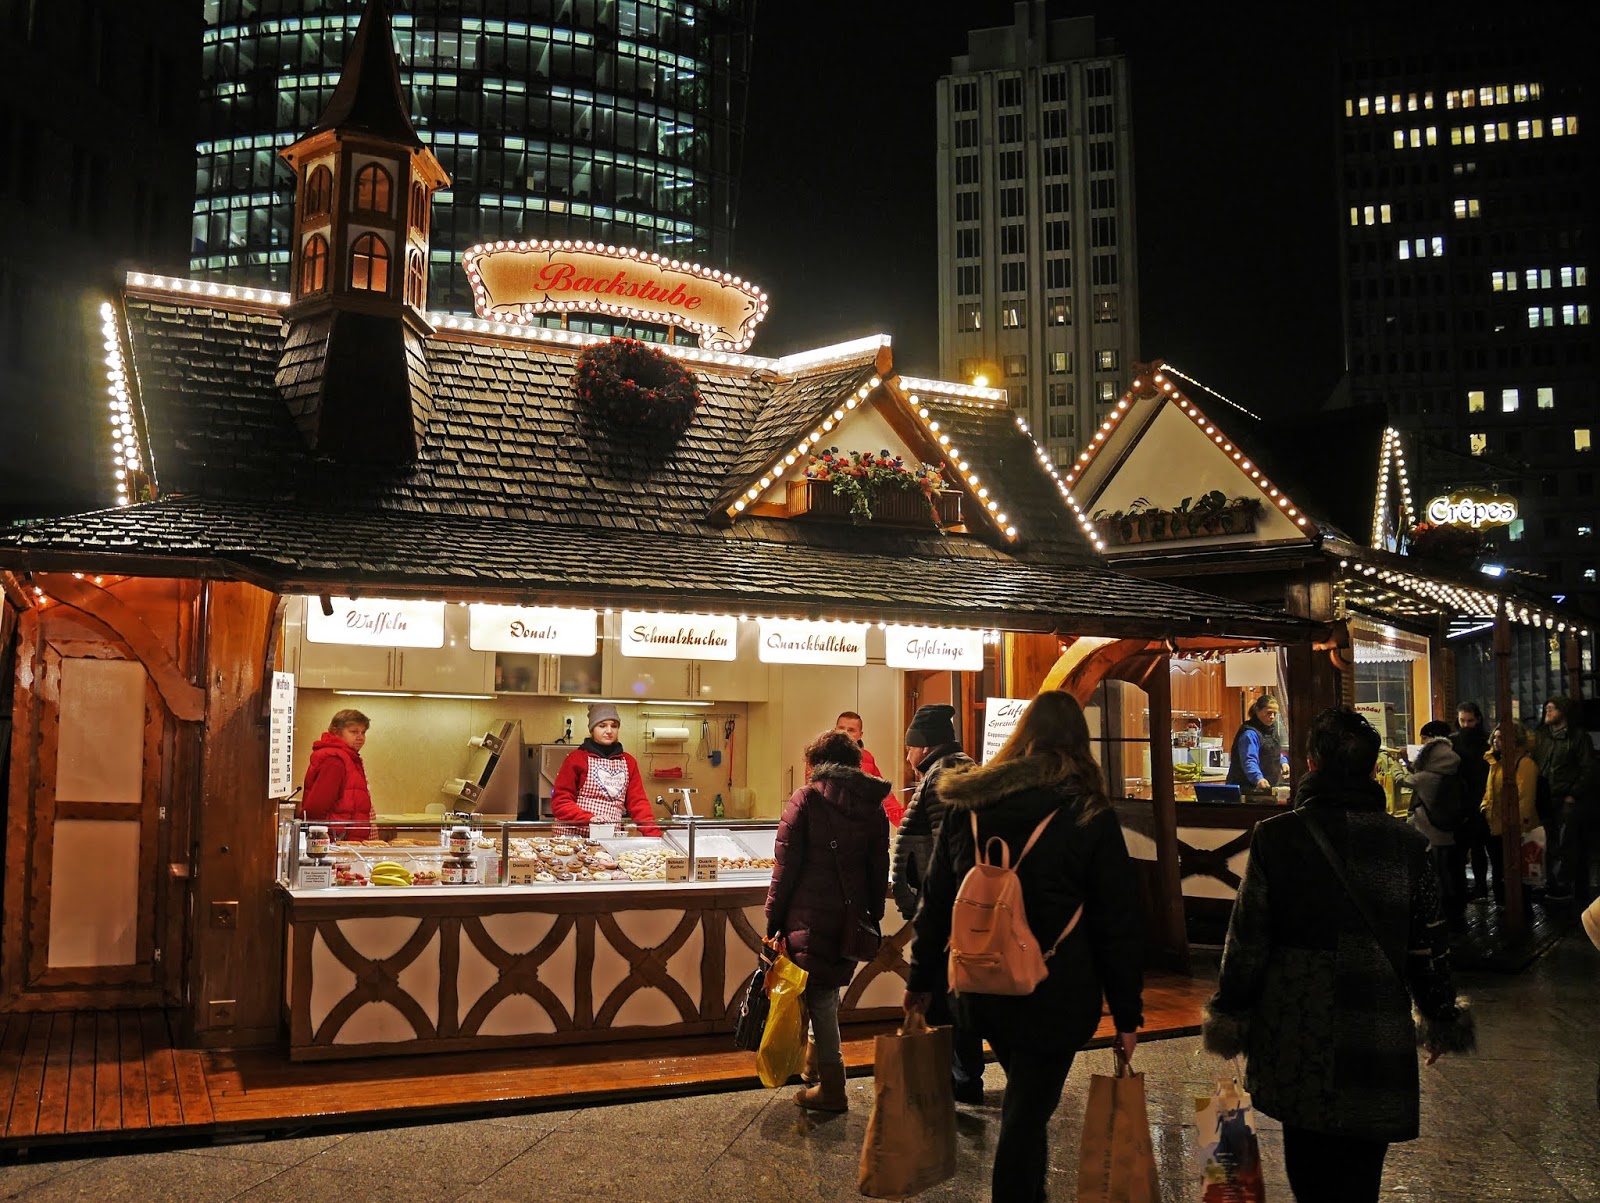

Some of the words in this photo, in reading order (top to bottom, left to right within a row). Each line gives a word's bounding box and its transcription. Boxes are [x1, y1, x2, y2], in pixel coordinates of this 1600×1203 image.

[533, 262, 702, 309] Backstube
[1429, 498, 1516, 527] Crêpes
[346, 610, 407, 634] Waffeln
[628, 625, 728, 646] Schmalzkuchen
[906, 639, 964, 660] Apfelringe
